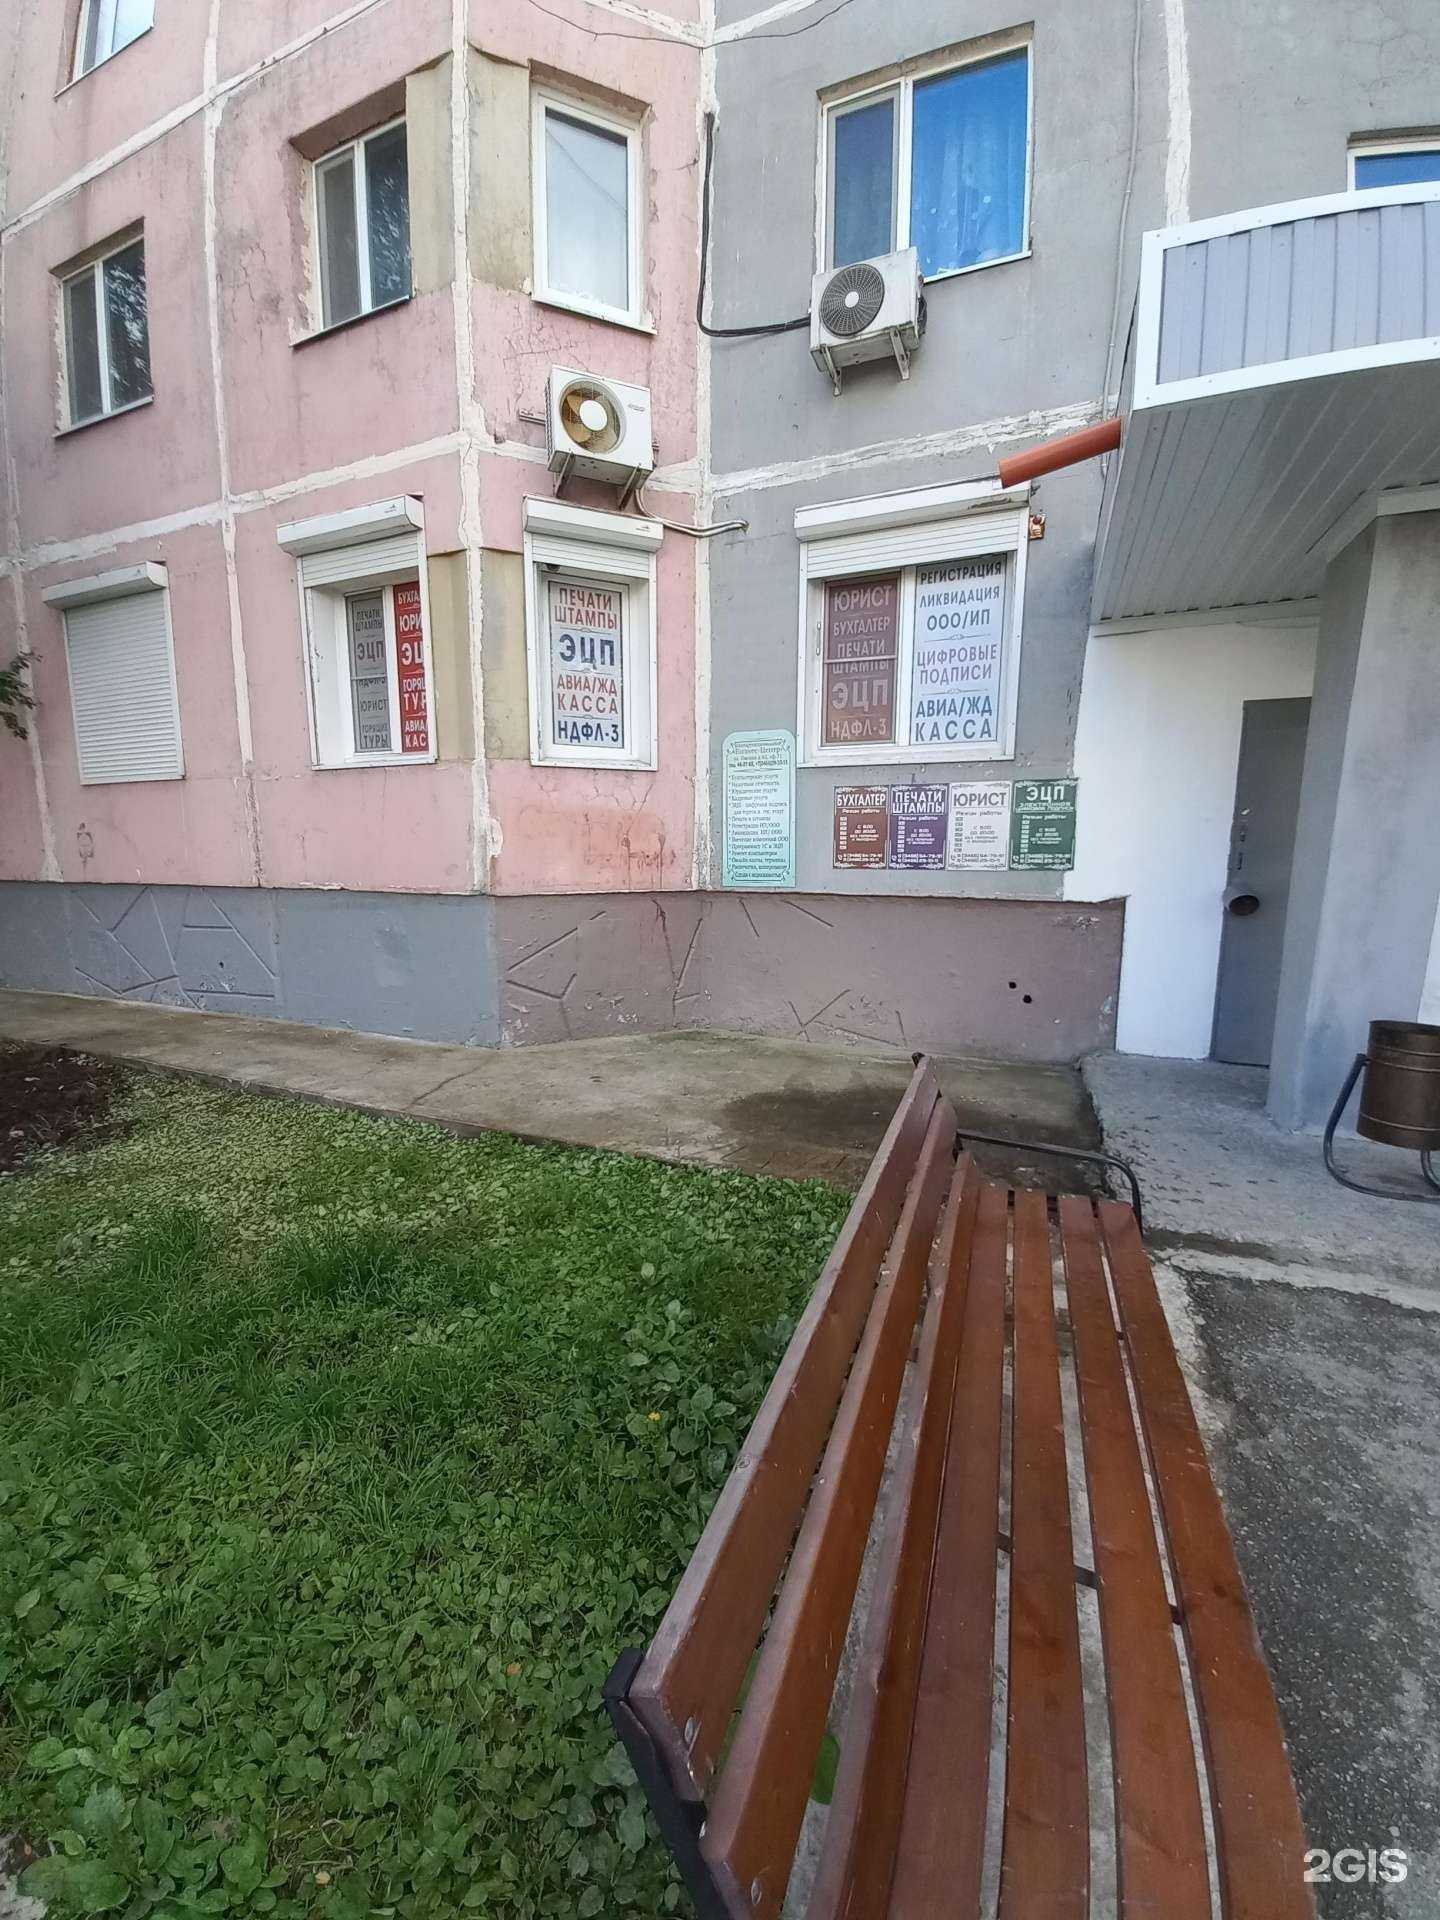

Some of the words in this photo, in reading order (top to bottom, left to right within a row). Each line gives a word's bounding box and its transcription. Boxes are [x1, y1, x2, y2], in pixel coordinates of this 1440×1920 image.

[920, 562, 1001, 585] РЕГИСТРАЦИЯ
[559, 588, 612, 611] ПЕЧАТИ
[834, 585, 893, 613] ЮРИСТ
[920, 586, 1000, 609] ЛИКВИДАЦИЯ
[555, 605, 617, 630] ШТАМПЫ
[833, 616, 890, 636] БУХГАЛТЕР
[927, 609, 991, 631] ООО/ИП
[357, 640, 384, 662] ЭЦП
[559, 634, 615, 670] ЭЦП
[837, 640, 885, 658] ПЕЧАТИ
[917, 644, 998, 669] ЦИФРОВЫЕ
[557, 674, 618, 697] АВИА/ЖД
[919, 664, 992, 686] ПОДПИСИ
[360, 699, 387, 712] ЮРИСТ
[557, 693, 618, 715] КАССА
[831, 679, 888, 712] ЭЦП
[916, 696, 992, 719] АВИА/ЖД
[405, 733, 426, 747] КАС
[558, 720, 619, 743] НДФЛ-3
[830, 719, 887, 739] НДФЛ-3
[915, 718, 992, 742] КАССА
[363, 733, 388, 749] ТУРЫ
[837, 793, 886, 806] БУХГАЛТЕР
[895, 791, 942, 803] ПЕЧАТИ
[953, 792, 1007, 807] ЮРИСТ
[1026, 786, 1065, 803] ЭЦП
[892, 801, 945, 814] ШТАМПЫ
